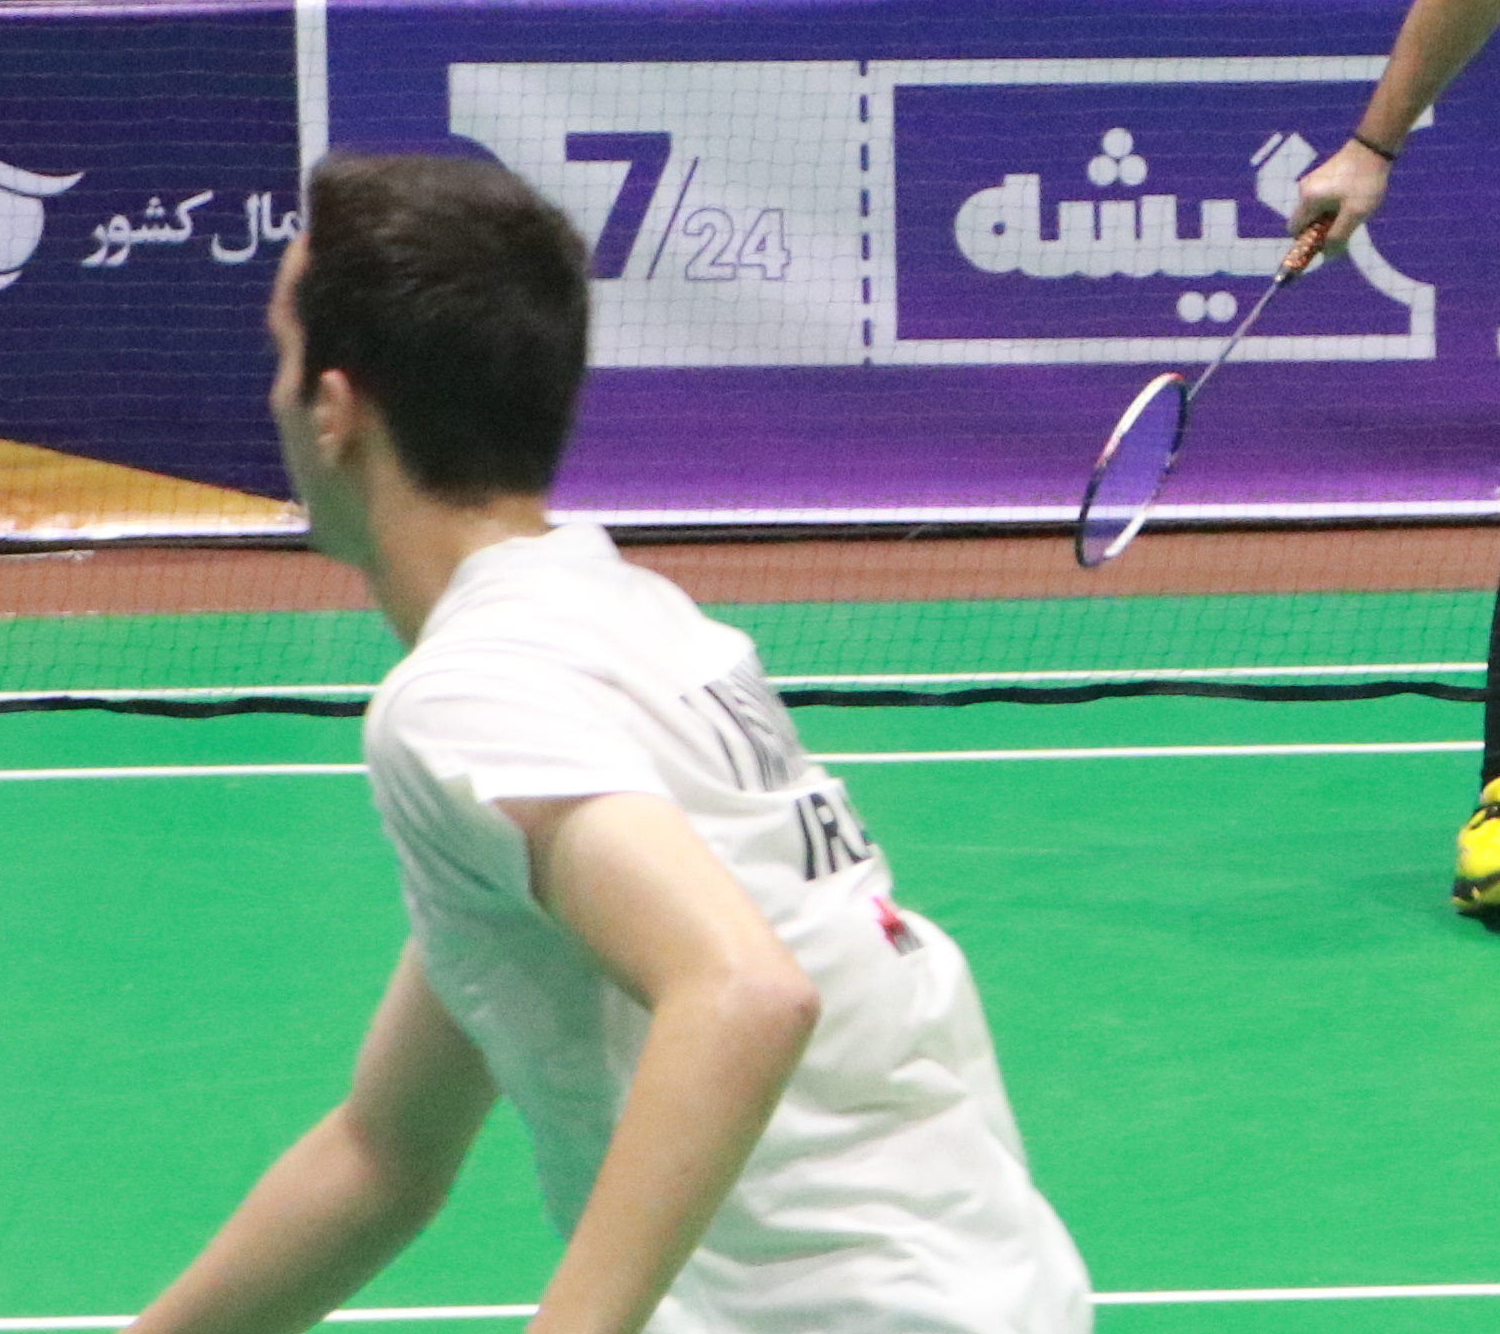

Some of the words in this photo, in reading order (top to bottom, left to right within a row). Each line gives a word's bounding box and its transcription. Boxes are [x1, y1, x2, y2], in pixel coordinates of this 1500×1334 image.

[81, 189, 215, 267] کشور
[565, 131, 792, 281] 7/24
[954, 127, 1326, 324] گیشه
